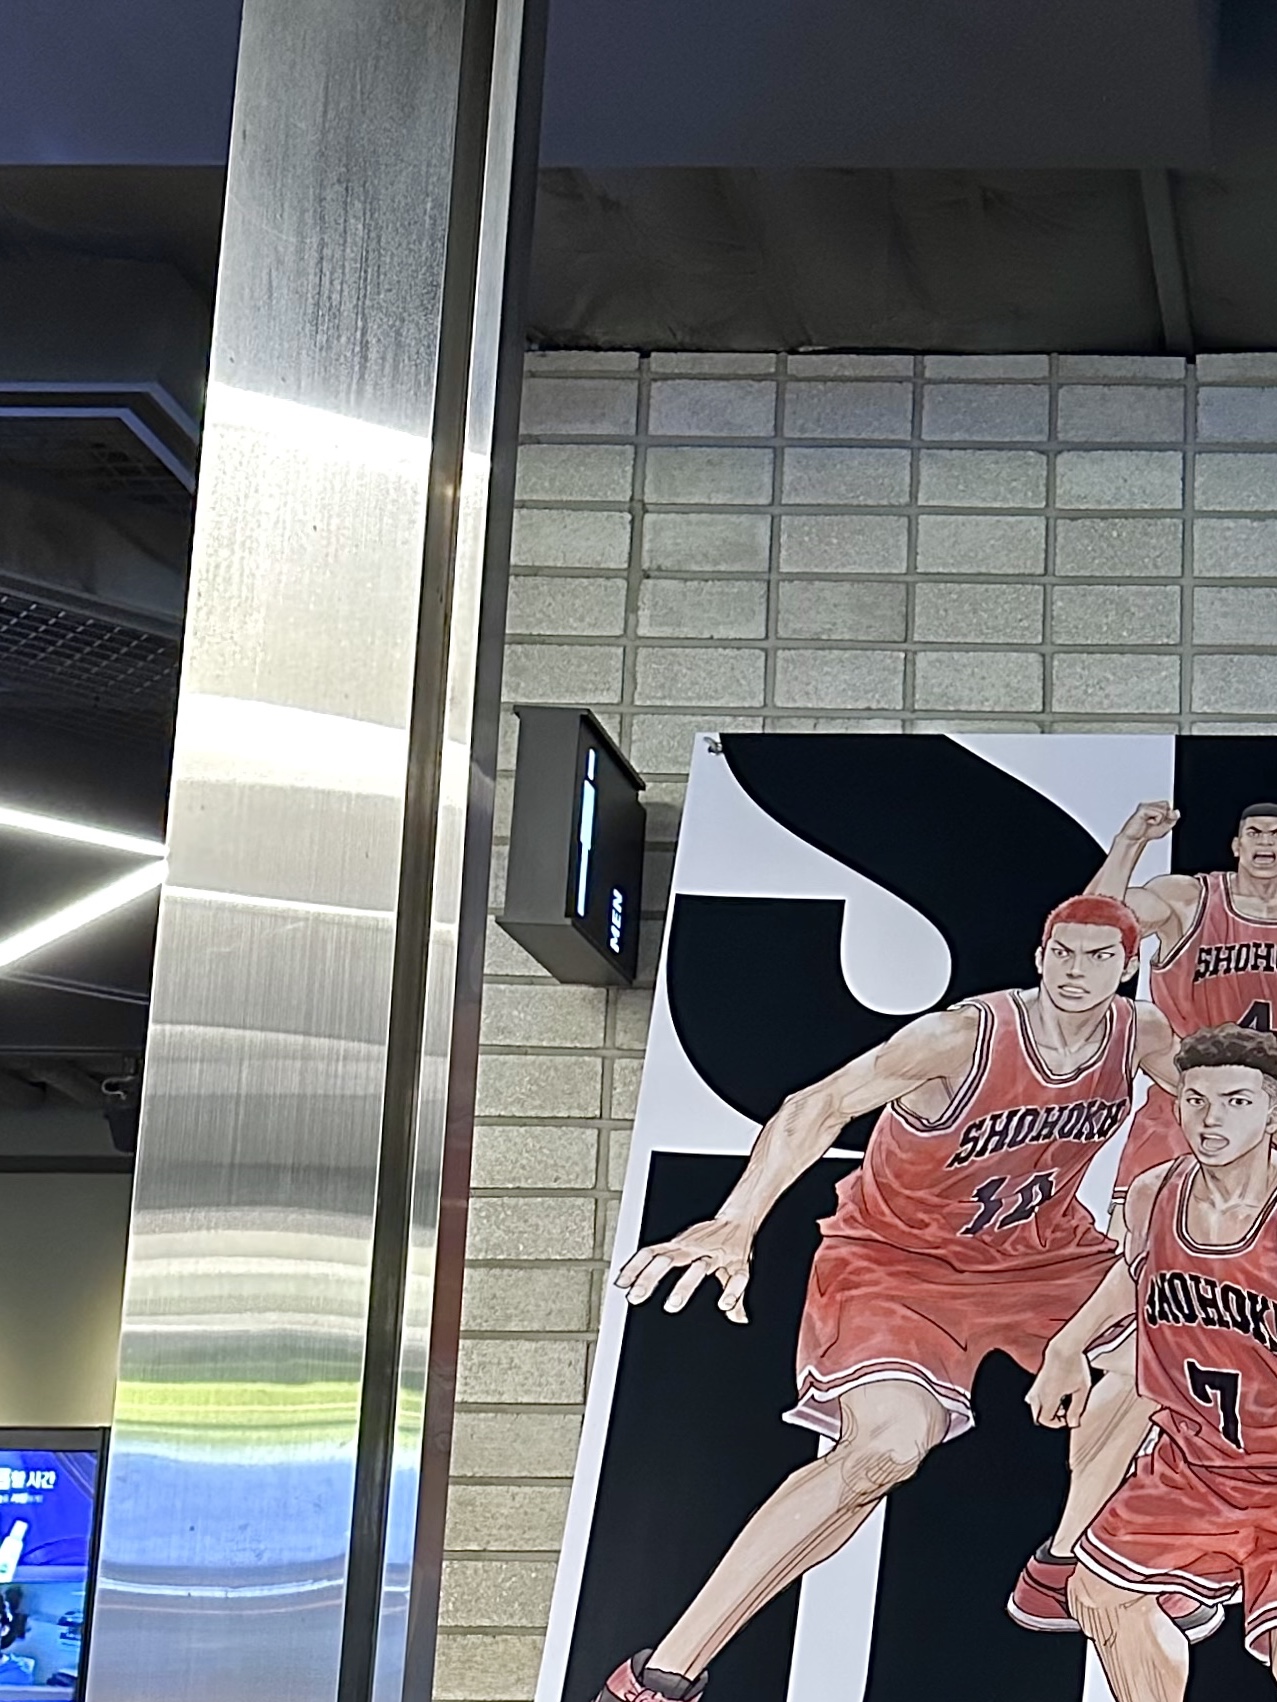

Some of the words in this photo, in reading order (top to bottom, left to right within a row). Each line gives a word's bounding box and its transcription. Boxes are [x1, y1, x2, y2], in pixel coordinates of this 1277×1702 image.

[609, 888, 624, 954] MEN
[944, 1097, 1131, 1171] SHOHOKU
[957, 1168, 1060, 1237] 10
[1185, 1359, 1244, 1451] 7
